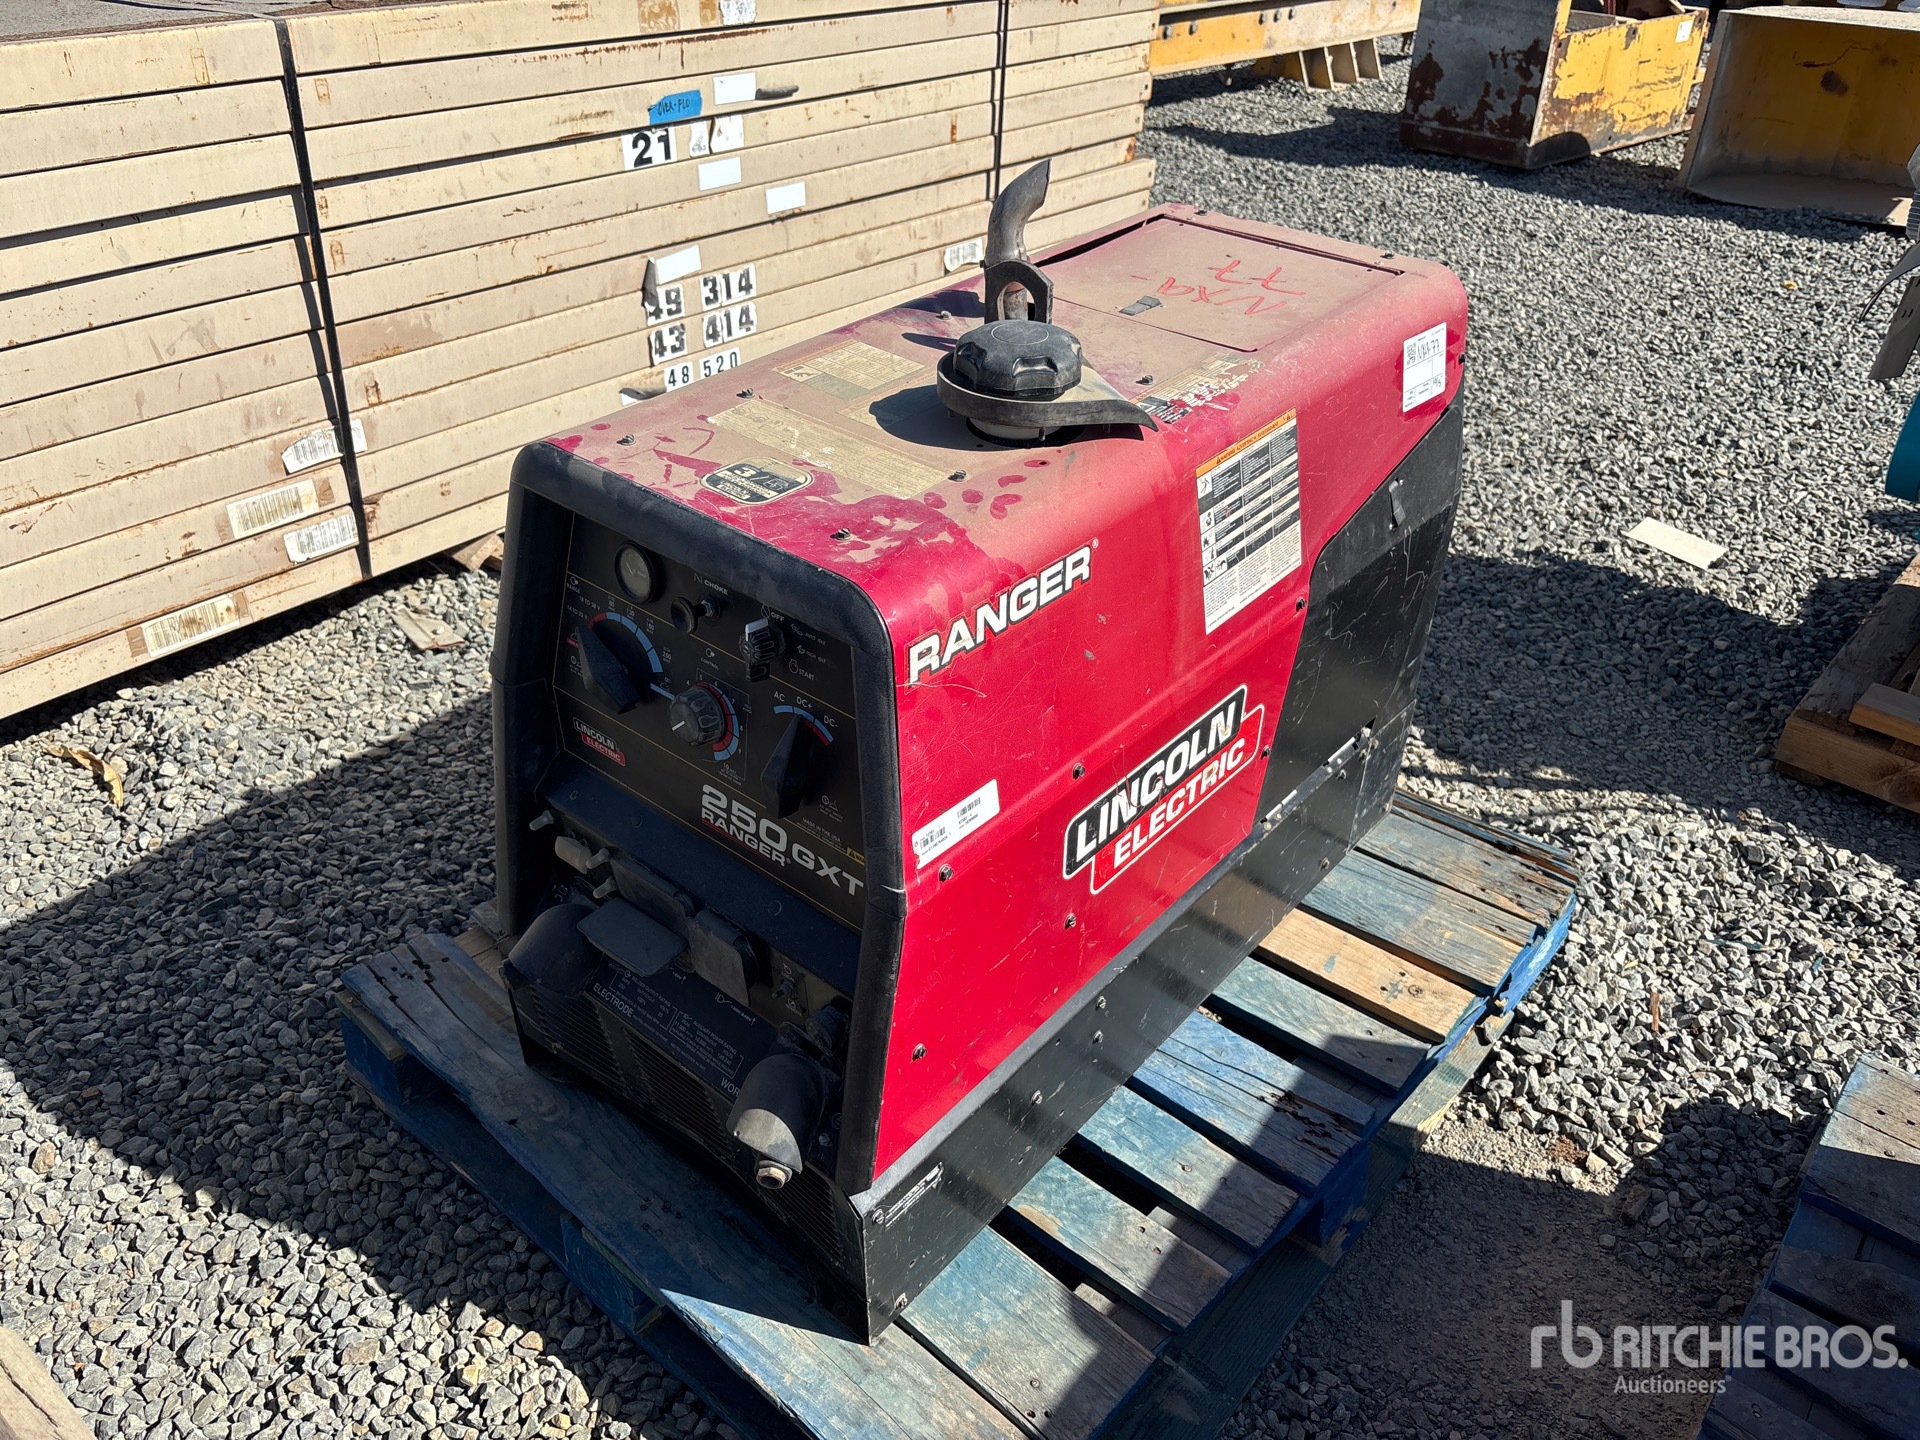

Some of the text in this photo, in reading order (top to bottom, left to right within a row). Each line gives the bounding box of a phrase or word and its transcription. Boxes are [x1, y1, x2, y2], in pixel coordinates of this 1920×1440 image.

[632, 127, 672, 168] 21
[702, 267, 754, 306] 314
[653, 304, 755, 358] 43 414
[668, 351, 739, 388] 48 520
[704, 579, 729, 596] CHOKE
[770, 611, 785, 622] OFF
[908, 545, 1091, 686] RANGER
[700, 657, 720, 670] CONTROL
[798, 668, 815, 681] START
[773, 691, 786, 703] AC
[796, 696, 813, 710] DC+
[575, 720, 615, 750] LINCOLN
[823, 715, 839, 728] DC-
[586, 738, 621, 762] ELECTRIC
[1075, 701, 1237, 862] LINCOLN
[701, 784, 788, 852] 250
[1113, 739, 1245, 869] ELECTRIC
[700, 808, 785, 868] RANGER
[802, 817, 816, 828] MADE
[822, 828, 831, 838] THE
[831, 833, 841, 843] USA
[792, 841, 864, 897] GXT
[592, 982, 635, 1018] ELECTRODE
[720, 1077, 742, 1097] WOR
